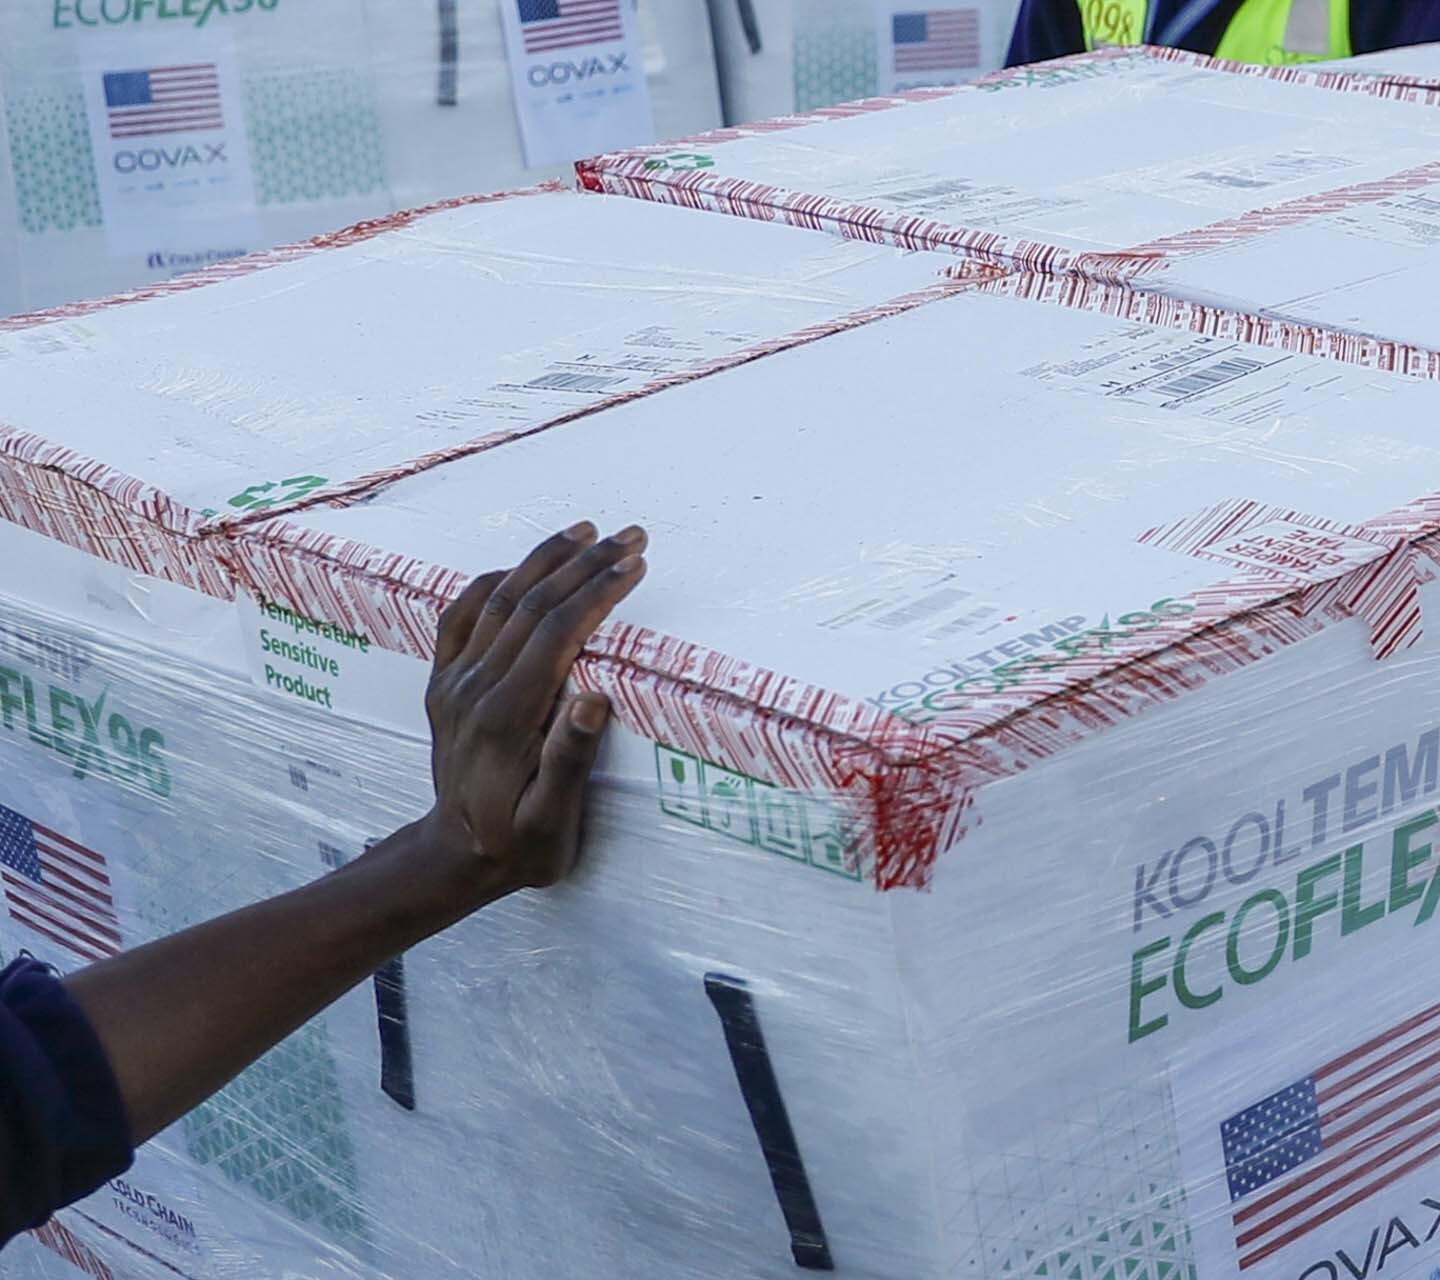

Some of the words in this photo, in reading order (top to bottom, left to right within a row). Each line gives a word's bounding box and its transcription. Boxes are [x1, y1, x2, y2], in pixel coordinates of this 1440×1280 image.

[526, 52, 630, 88] COVAX
[113, 142, 228, 175] COVAX
[259, 628, 340, 678] Sensitive
[265, 663, 333, 710] Product
[145, 1194, 196, 1239] CHAIN
